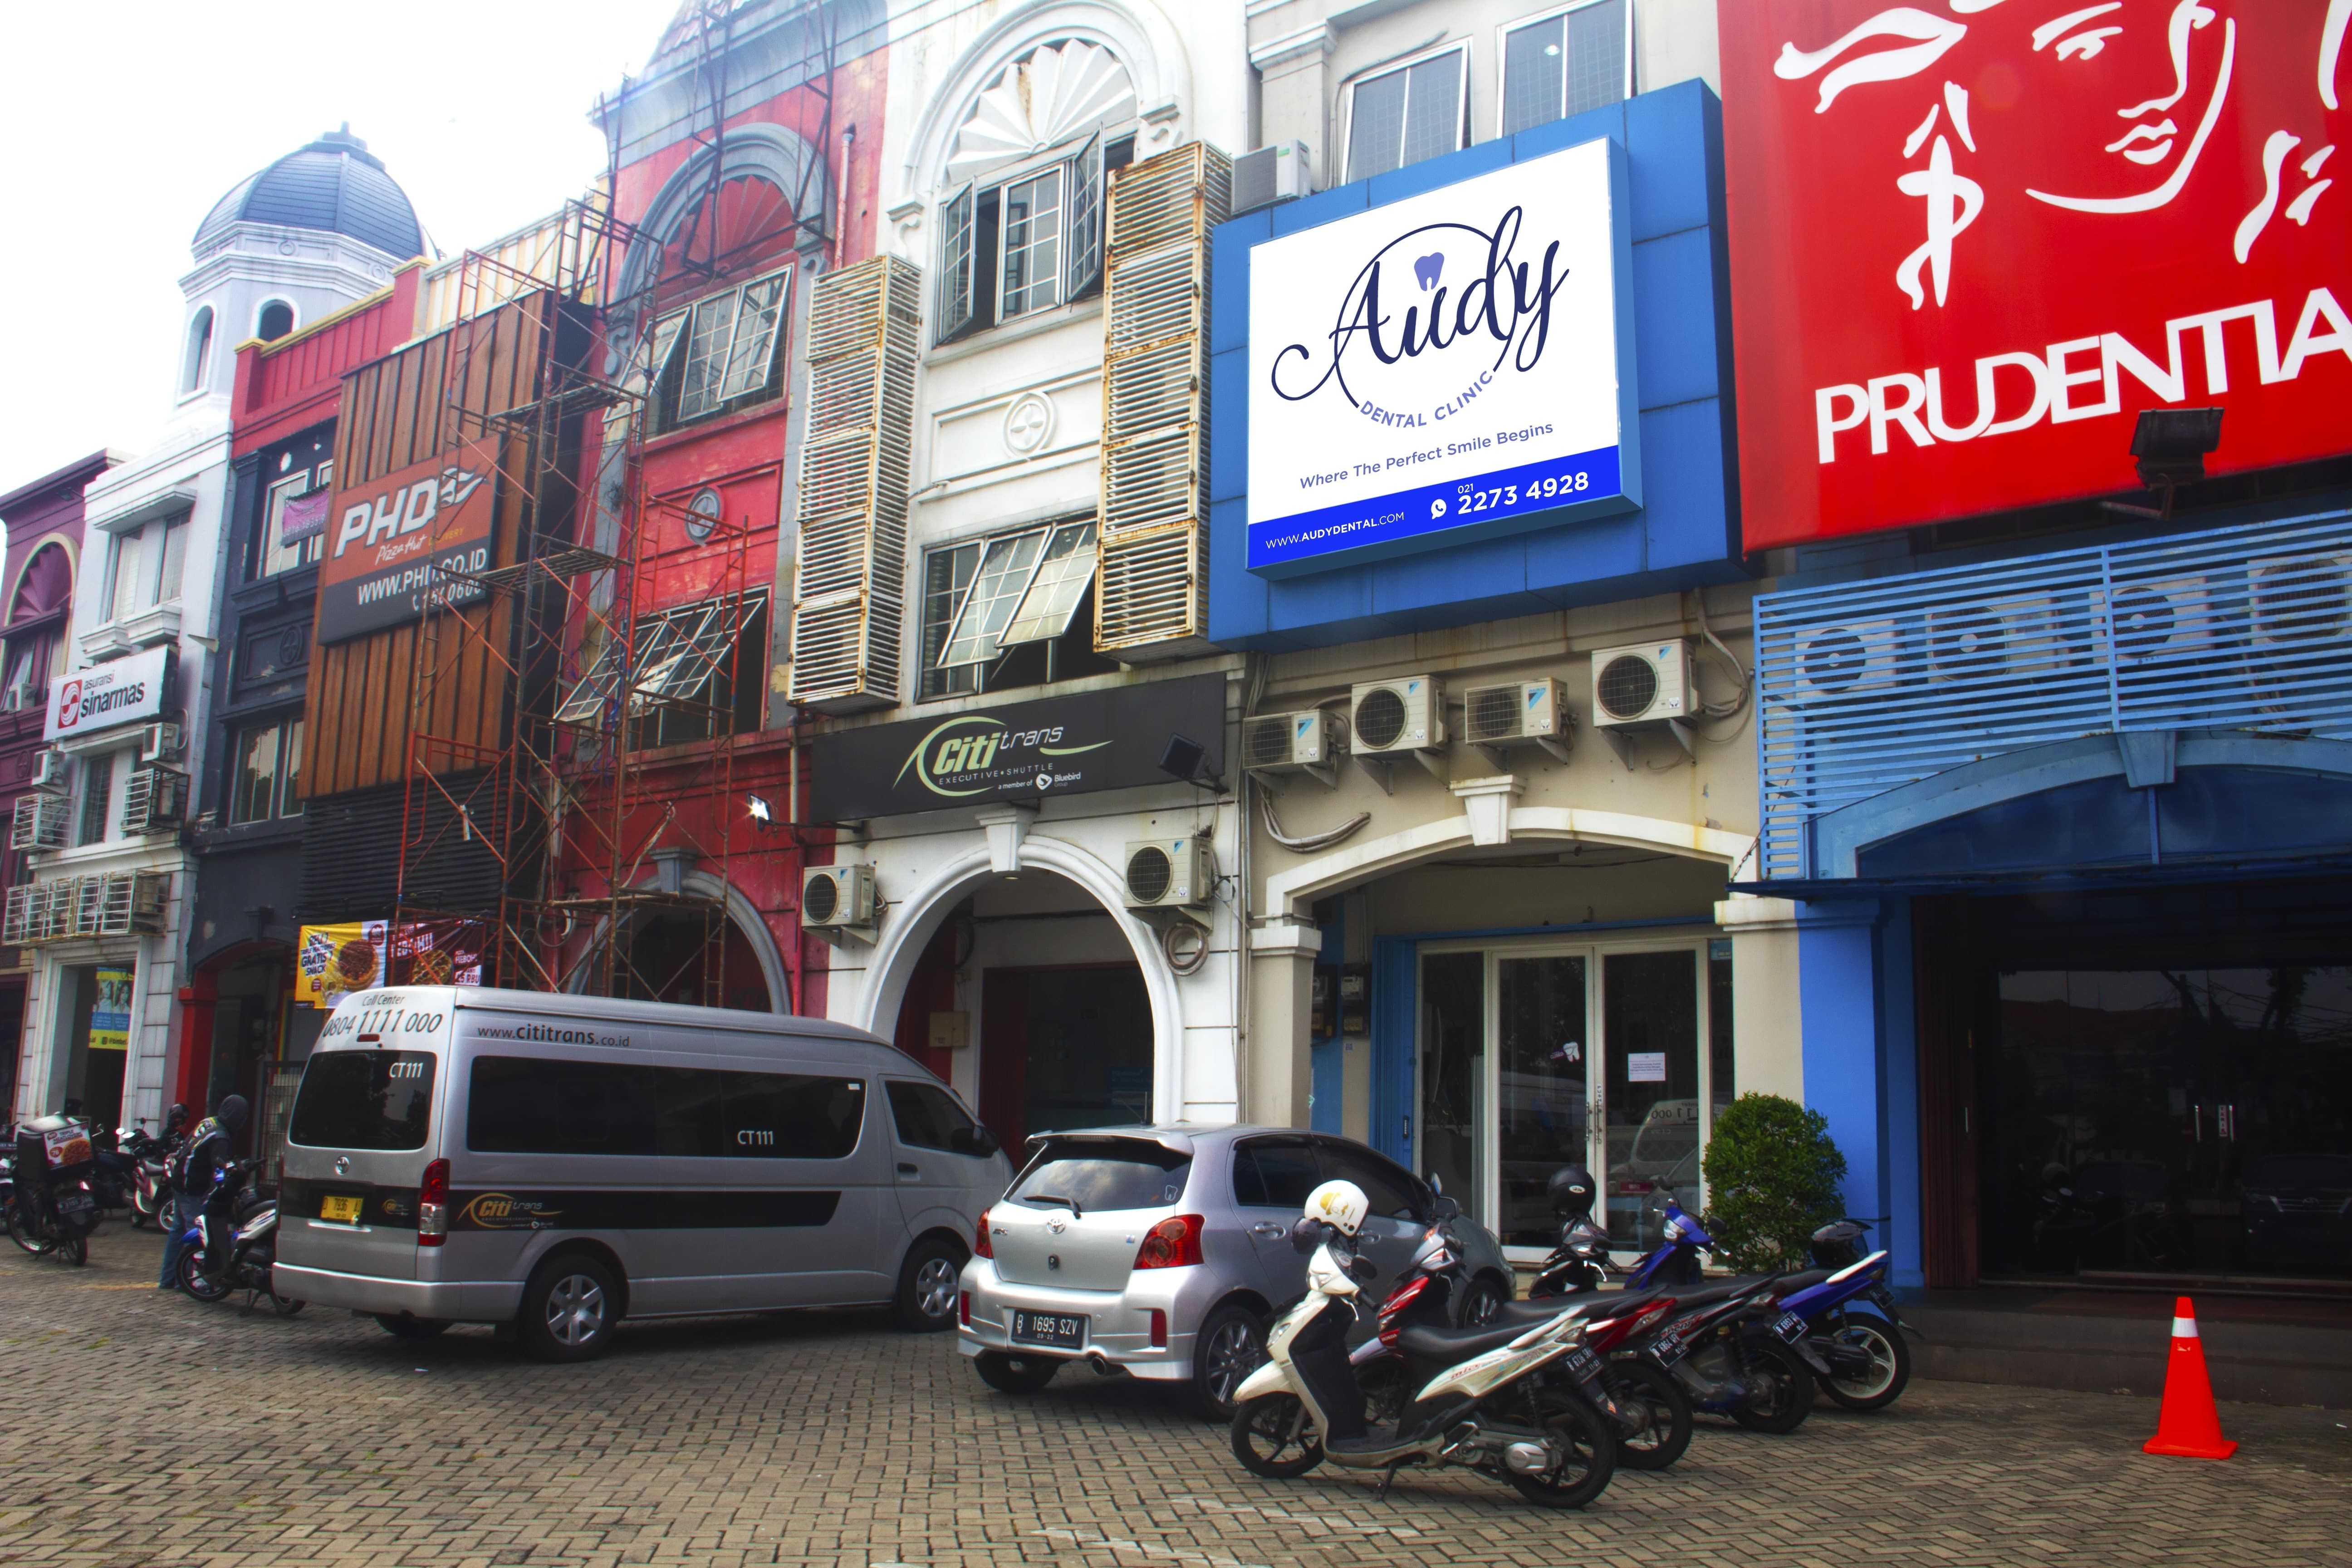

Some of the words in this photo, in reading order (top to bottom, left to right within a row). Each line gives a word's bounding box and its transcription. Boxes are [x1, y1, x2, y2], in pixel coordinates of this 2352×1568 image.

[1271, 206, 1569, 401] Audy
[1361, 401, 1427, 428] DENTAL
[1435, 370, 1493, 421] CLINIC
[1299, 470, 1348, 489] Where
[1354, 463, 1381, 476] The
[1386, 447, 1442, 470] Perfect
[1447, 434, 1491, 456] Smile
[1497, 422, 1553, 445] Begins
[1458, 484, 1474, 494] 021
[1458, 486, 1517, 514] 2273
[1526, 472, 1589, 499] 4928
[334, 479, 438, 557] PHD
[1266, 511, 1404, 549] WWW.AUDYDENTAL.COM
[375, 544, 403, 565] Pizza
[404, 534, 427, 554] Hut
[84, 669, 115, 690] asuransi
[80, 682, 145, 718] sinarmas
[939, 771, 998, 785] EXECUTIVE
[1007, 763, 1053, 775] SHUTTLE
[1054, 771, 1081, 782] Bluebird
[363, 995, 376, 1006] Call
[377, 995, 405, 1005] Center
[322, 1016, 357, 1038] 0804
[358, 1009, 405, 1033] 1111
[405, 1013, 443, 1033] 000
[478, 1024, 630, 1047] www.cititrans.co.id
[1017, 1314, 1024, 1329] B
[1033, 1316, 1055, 1333] 1695
[1059, 1318, 1078, 1335] SZV
